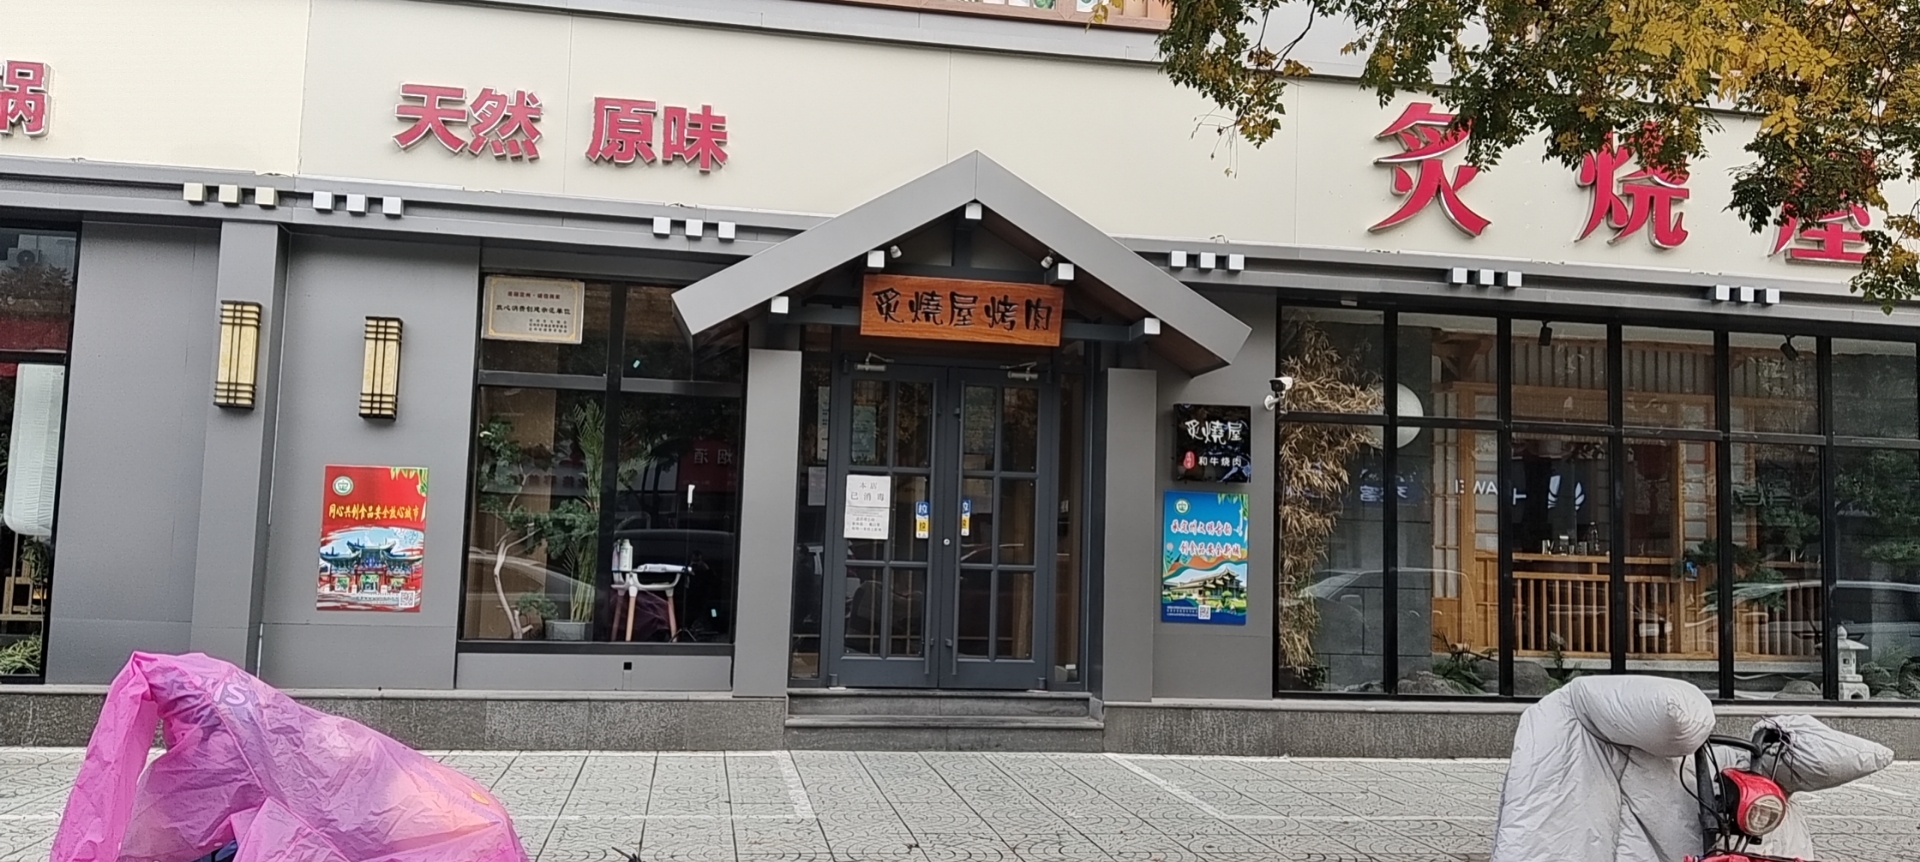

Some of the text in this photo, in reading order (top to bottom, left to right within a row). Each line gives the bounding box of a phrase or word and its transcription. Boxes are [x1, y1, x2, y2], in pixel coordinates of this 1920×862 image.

[393, 82, 729, 172] 天然 原味
[328, 503, 420, 522] 同心共创食品安全放心城市
